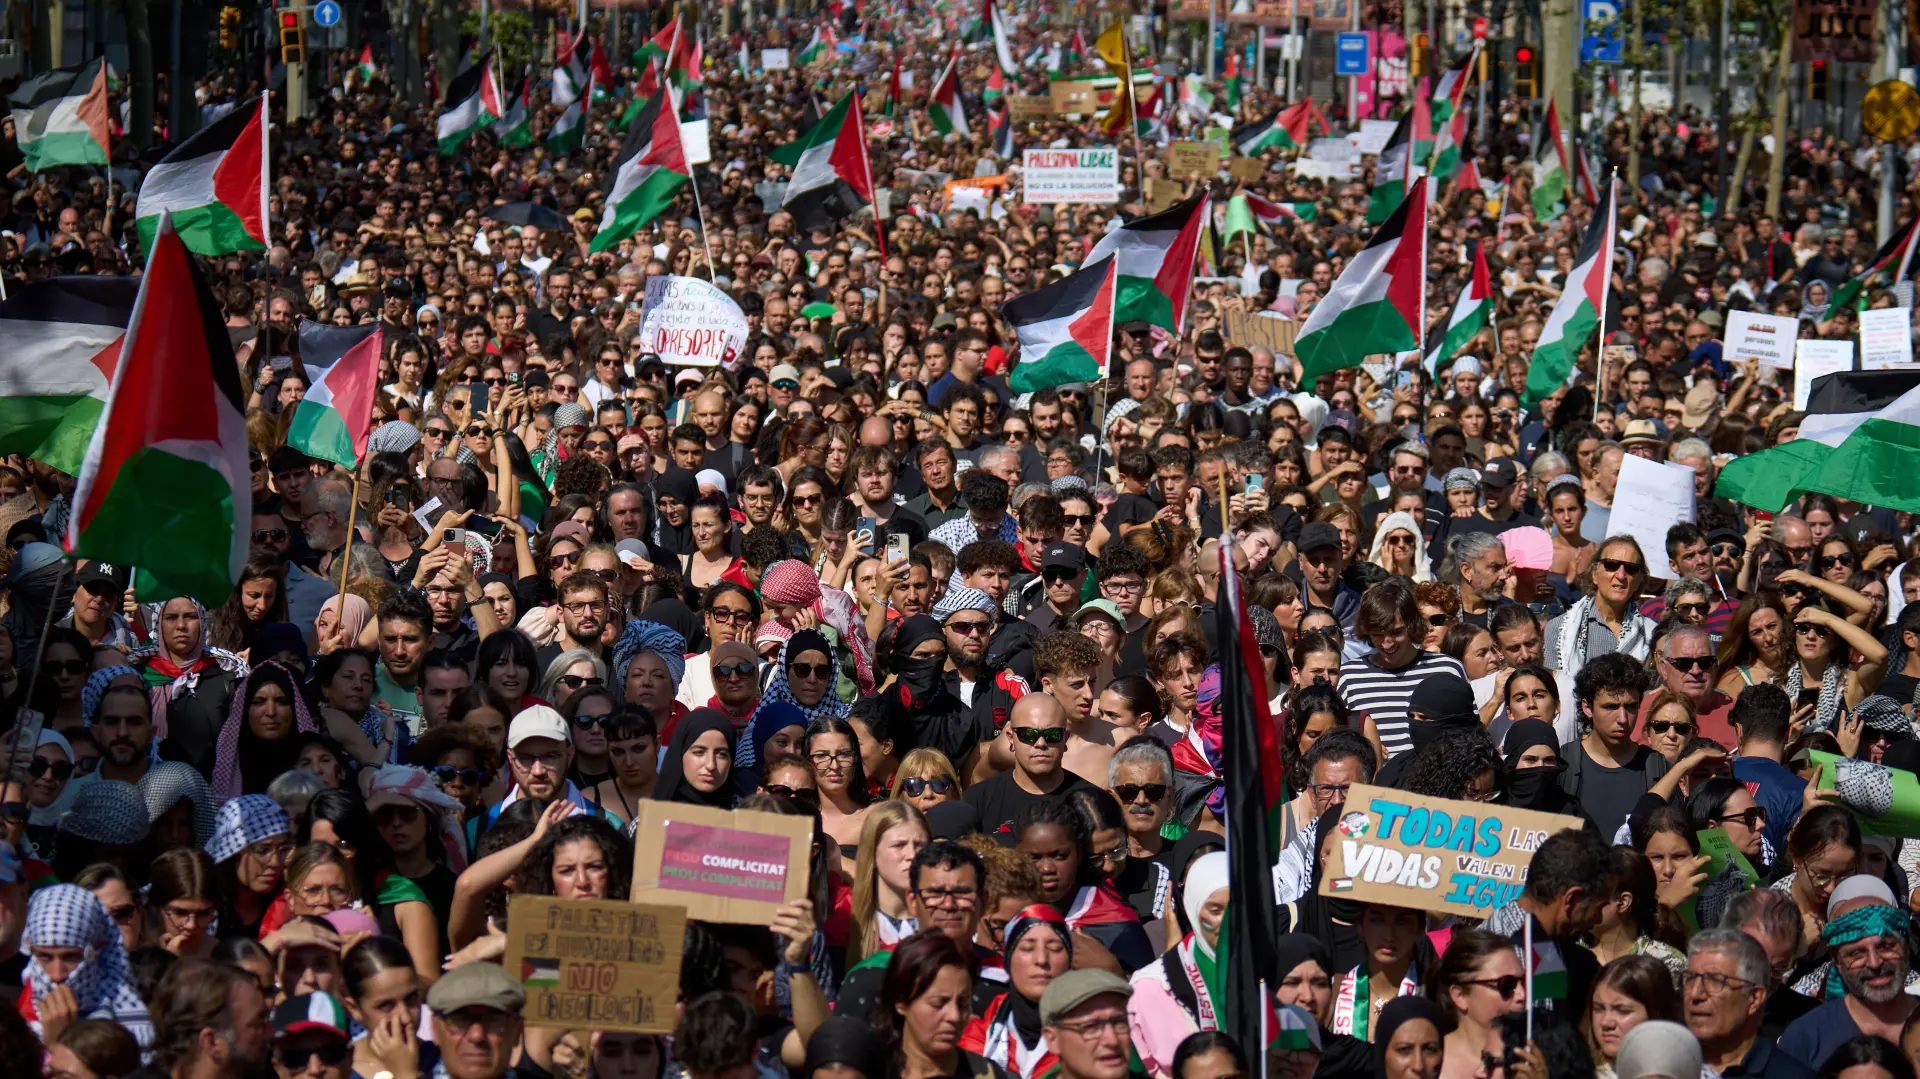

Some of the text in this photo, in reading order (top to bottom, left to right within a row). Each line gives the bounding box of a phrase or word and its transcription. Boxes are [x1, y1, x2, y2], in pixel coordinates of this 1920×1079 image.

[1028, 152, 1113, 168] PALESTINA LIBRE
[656, 327, 726, 360] OPRESORES
[100, 562, 113, 576] NY
[1369, 799, 1548, 858] TODAS LAS
[662, 865, 784, 892] PROU COMPLICITAT
[665, 850, 786, 876] PROU COMPLICITAT
[1341, 839, 1516, 890] VIDAS VALEN
[547, 905, 661, 940] PALESTINA
[567, 962, 618, 995] NO
